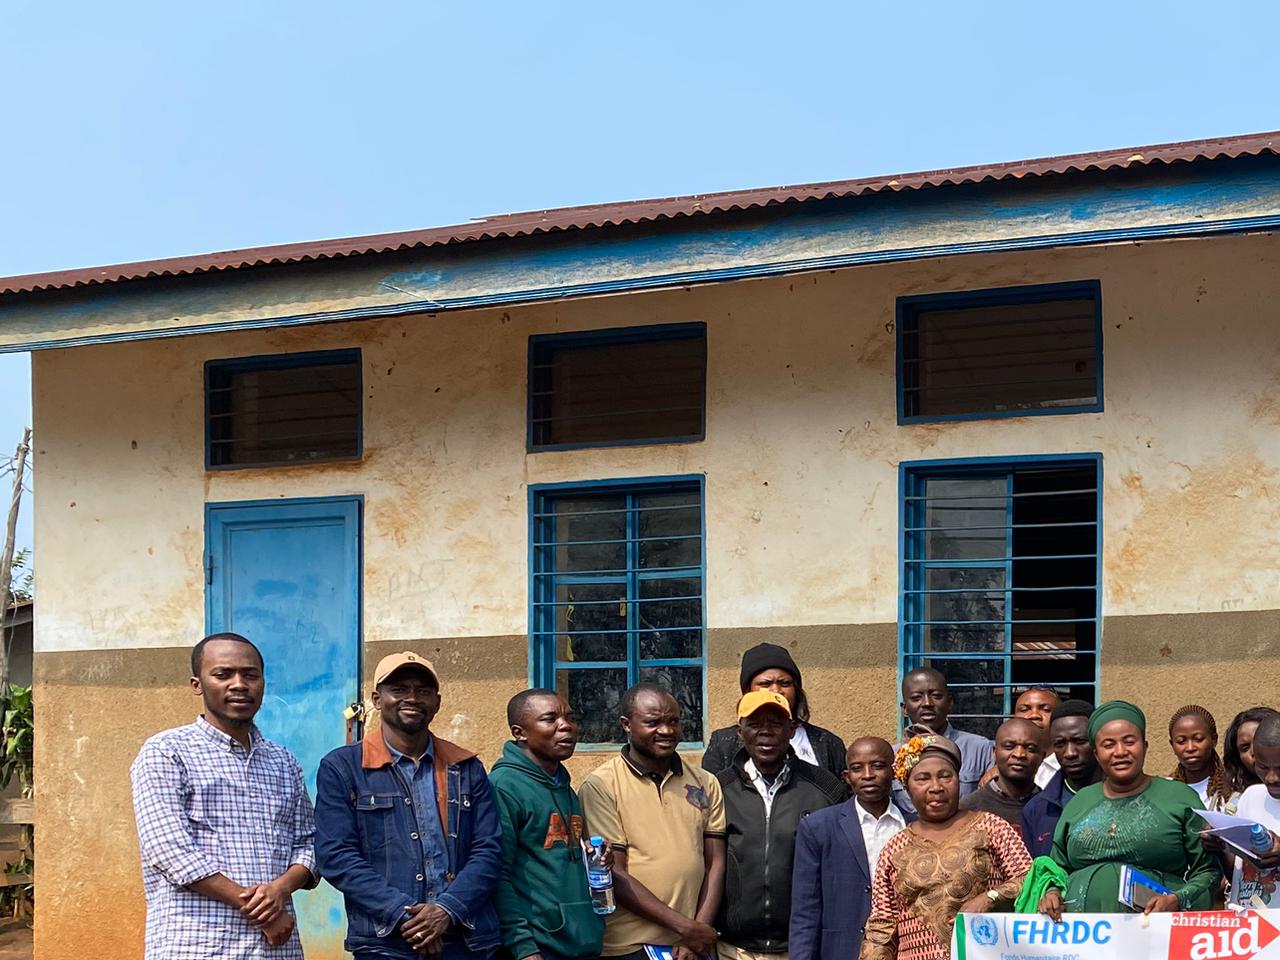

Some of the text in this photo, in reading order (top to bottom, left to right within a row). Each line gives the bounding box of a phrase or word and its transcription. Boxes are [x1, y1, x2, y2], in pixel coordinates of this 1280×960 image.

[1012, 919, 1112, 945] FHRDC
[1171, 912, 1241, 928] christian
[1190, 916, 1262, 960] aid
